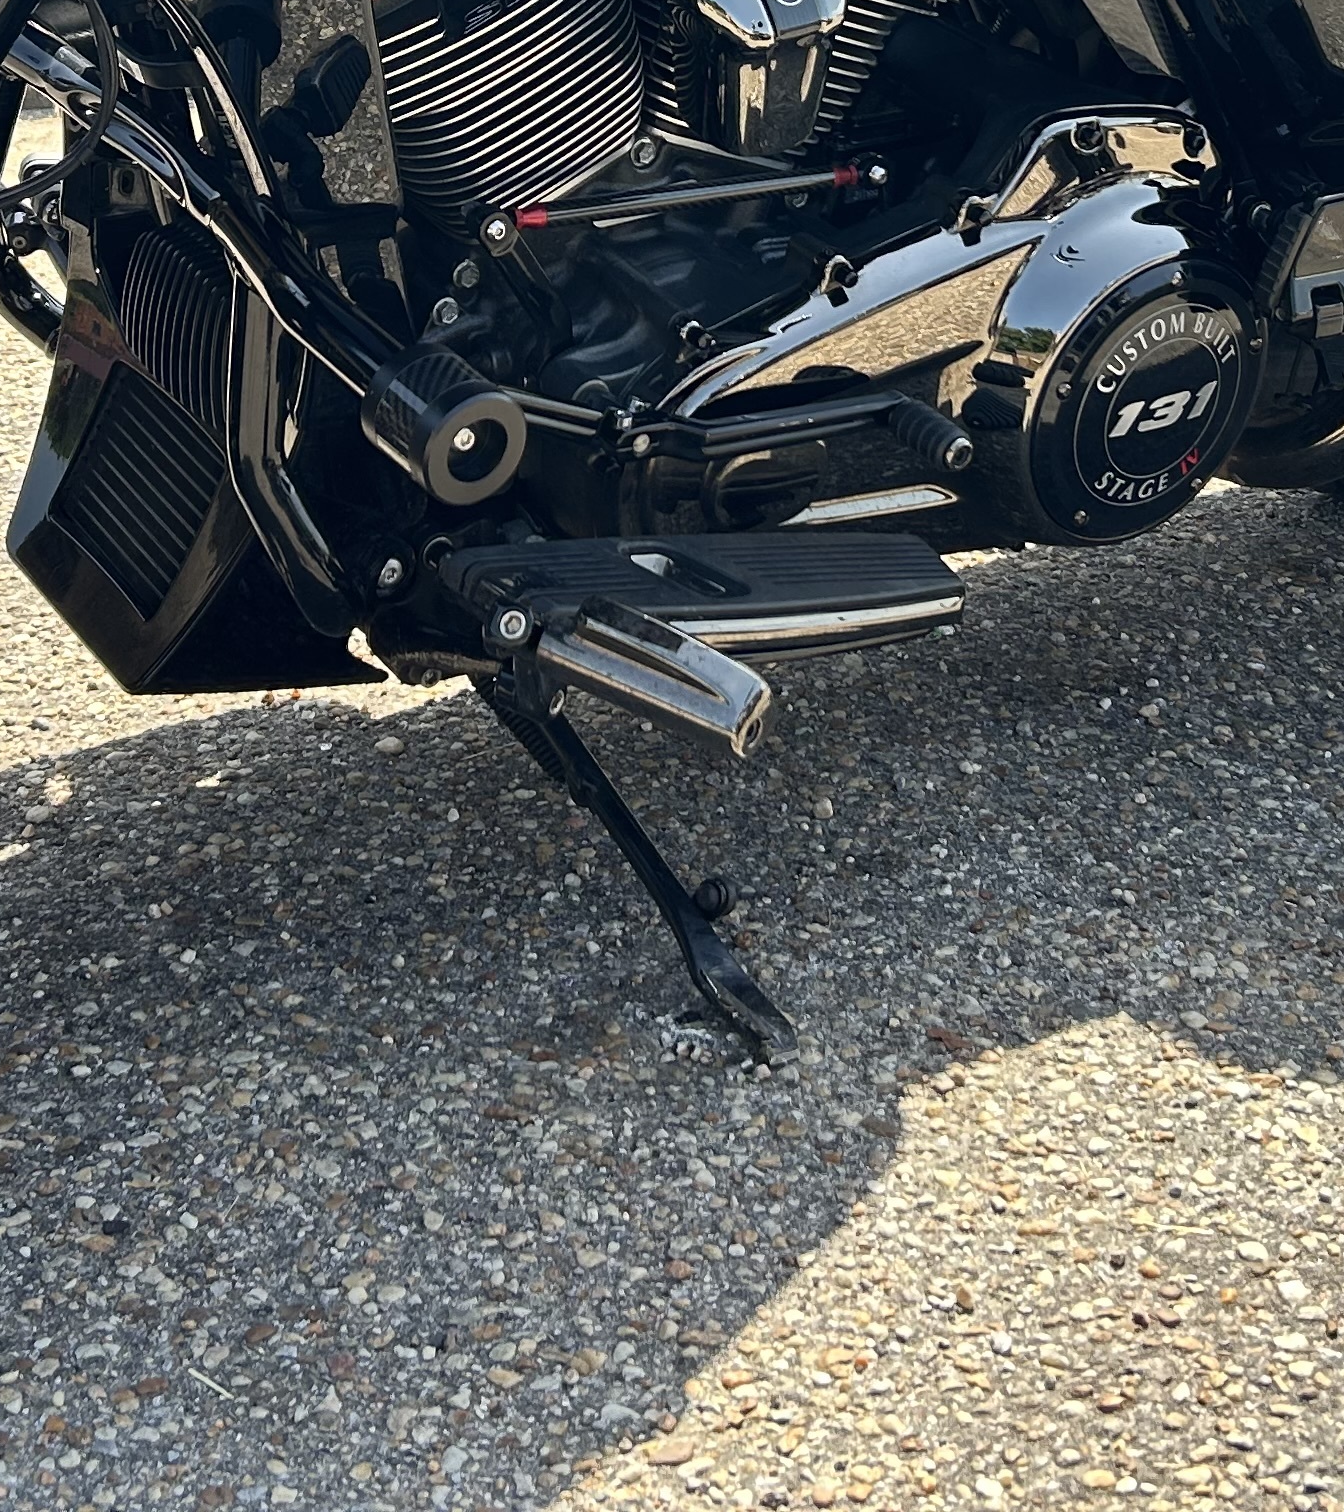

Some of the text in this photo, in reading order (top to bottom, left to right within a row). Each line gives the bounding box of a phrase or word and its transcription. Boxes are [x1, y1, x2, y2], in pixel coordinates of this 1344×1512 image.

[1096, 311, 1236, 395] CUSTOM BUILT
[1108, 380, 1218, 438] 131
[1093, 447, 1201, 501] STAGE IV
